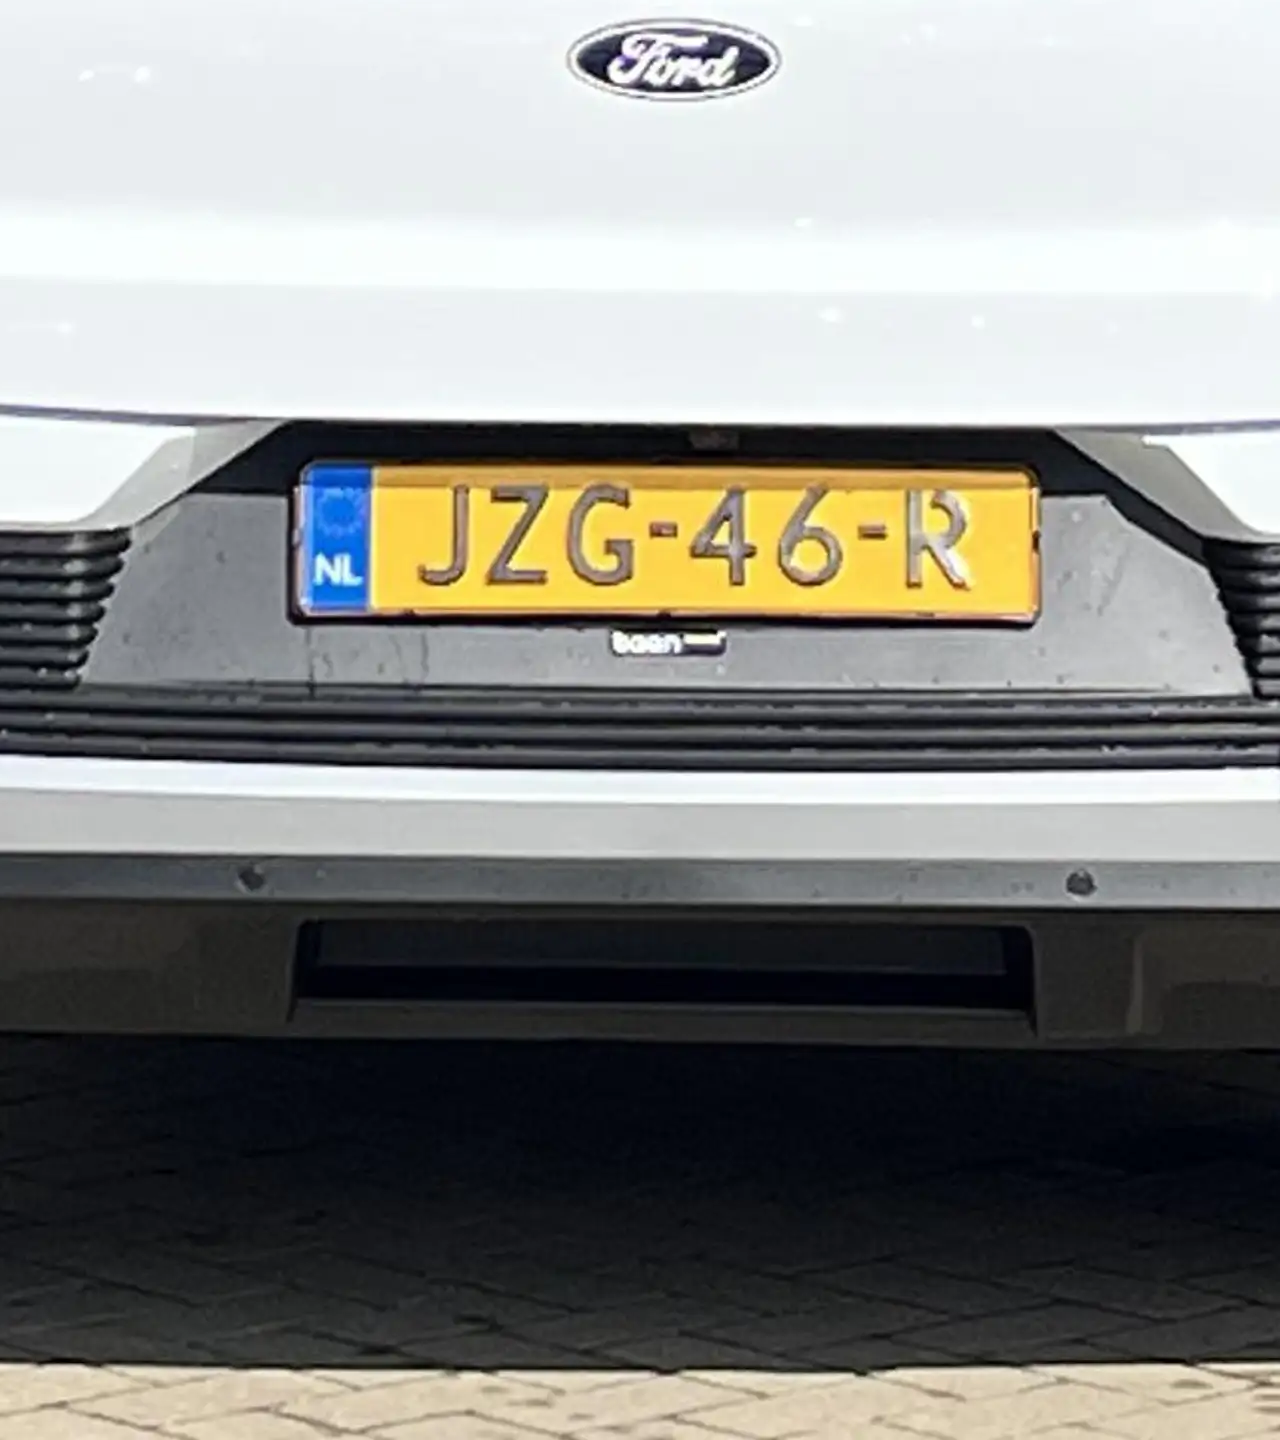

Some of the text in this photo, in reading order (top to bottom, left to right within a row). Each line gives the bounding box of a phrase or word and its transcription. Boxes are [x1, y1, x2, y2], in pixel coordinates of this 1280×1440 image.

[607, 33, 740, 87] Ford
[419, 483, 971, 590] JZG-46-R
[313, 552, 363, 586] NL
